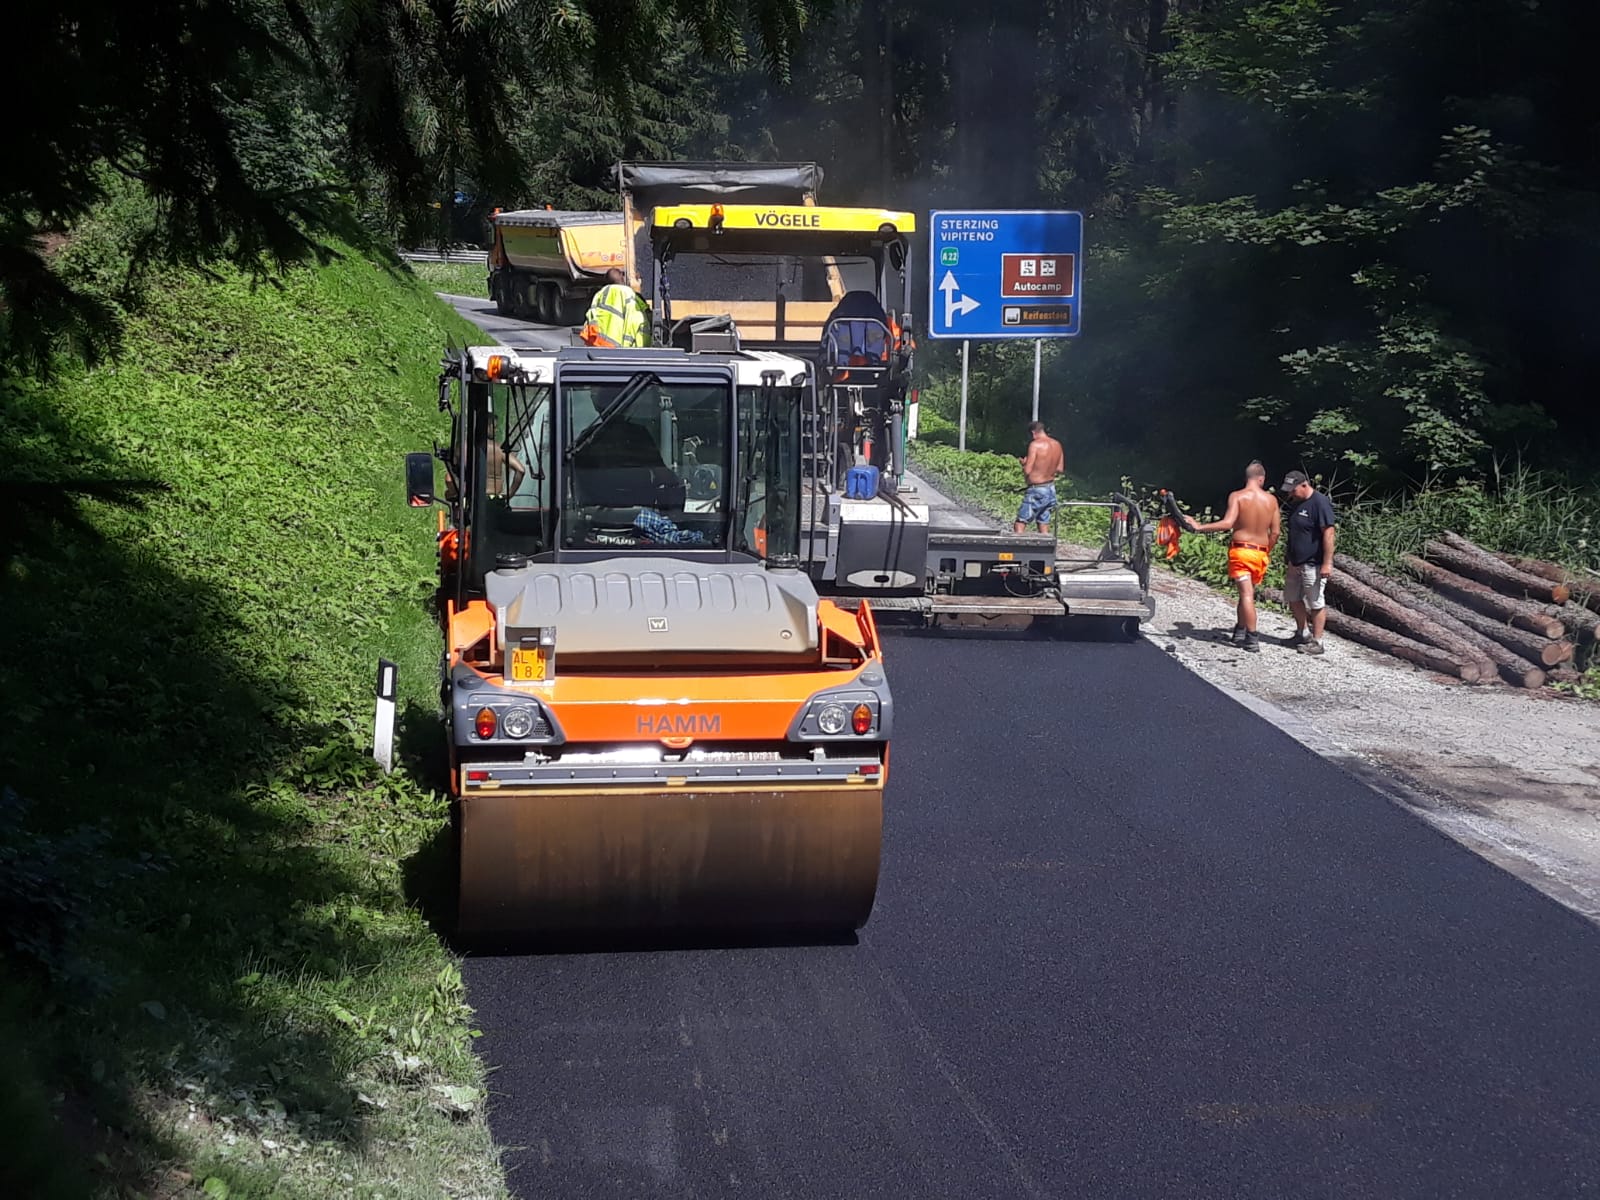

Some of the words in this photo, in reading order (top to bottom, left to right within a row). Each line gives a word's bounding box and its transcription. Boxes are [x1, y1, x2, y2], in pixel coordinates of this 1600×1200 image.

[755, 210, 820, 227] VÖGELE
[941, 220, 999, 229] STERZING
[941, 232, 994, 241] VIPITENO
[1013, 282, 1062, 292] Autocamp
[514, 651, 529, 664] AL
[514, 665, 545, 679] 182
[637, 714, 721, 734] HAMM
